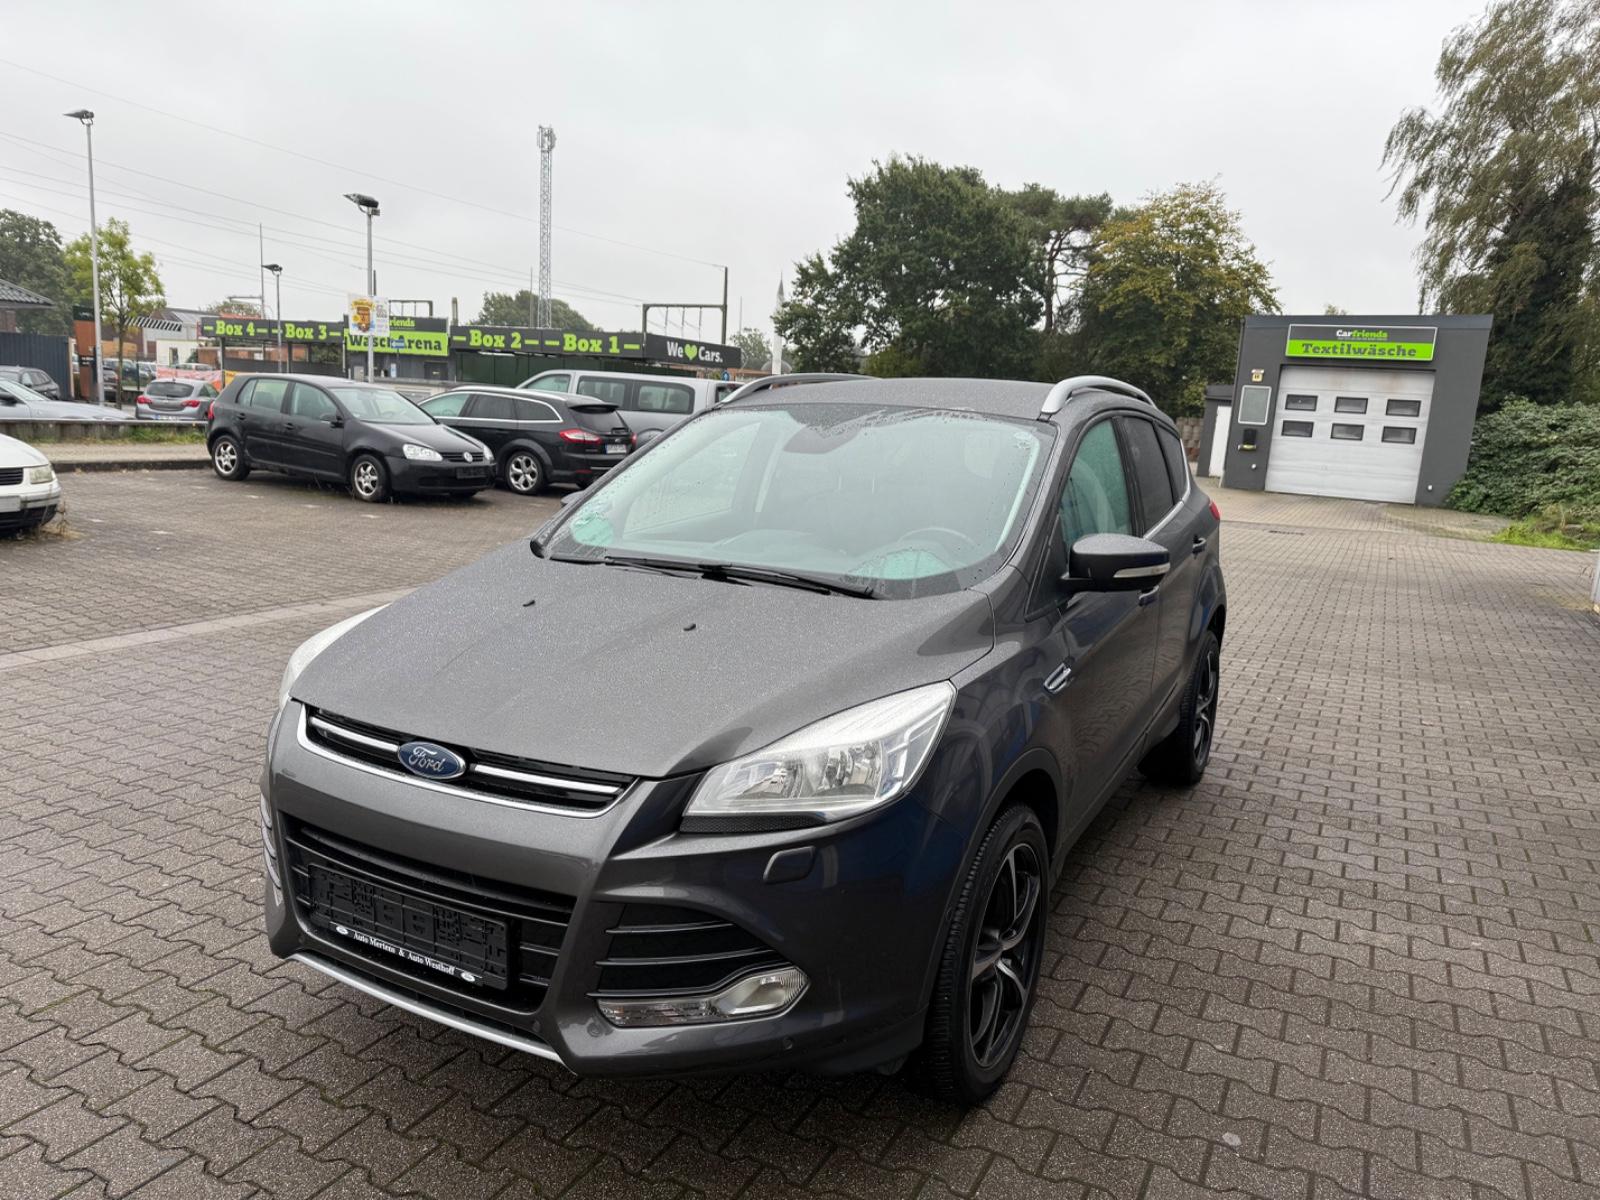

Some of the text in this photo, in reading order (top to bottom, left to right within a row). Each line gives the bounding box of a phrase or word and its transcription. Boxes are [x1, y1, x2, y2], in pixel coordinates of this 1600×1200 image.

[215, 320, 255, 336] Box 4
[285, 323, 327, 340] Box 3
[1336, 329, 1388, 339] Carfriends
[469, 329, 521, 349] Box 2
[563, 333, 620, 353] Box 1
[666, 341, 723, 363] We Cars.
[1302, 342, 1417, 357] Textilwäsche
[408, 746, 447, 772] Ford
[353, 931, 370, 944] Auto
[398, 948, 405, 957] &
[407, 952, 424, 964] Auto
